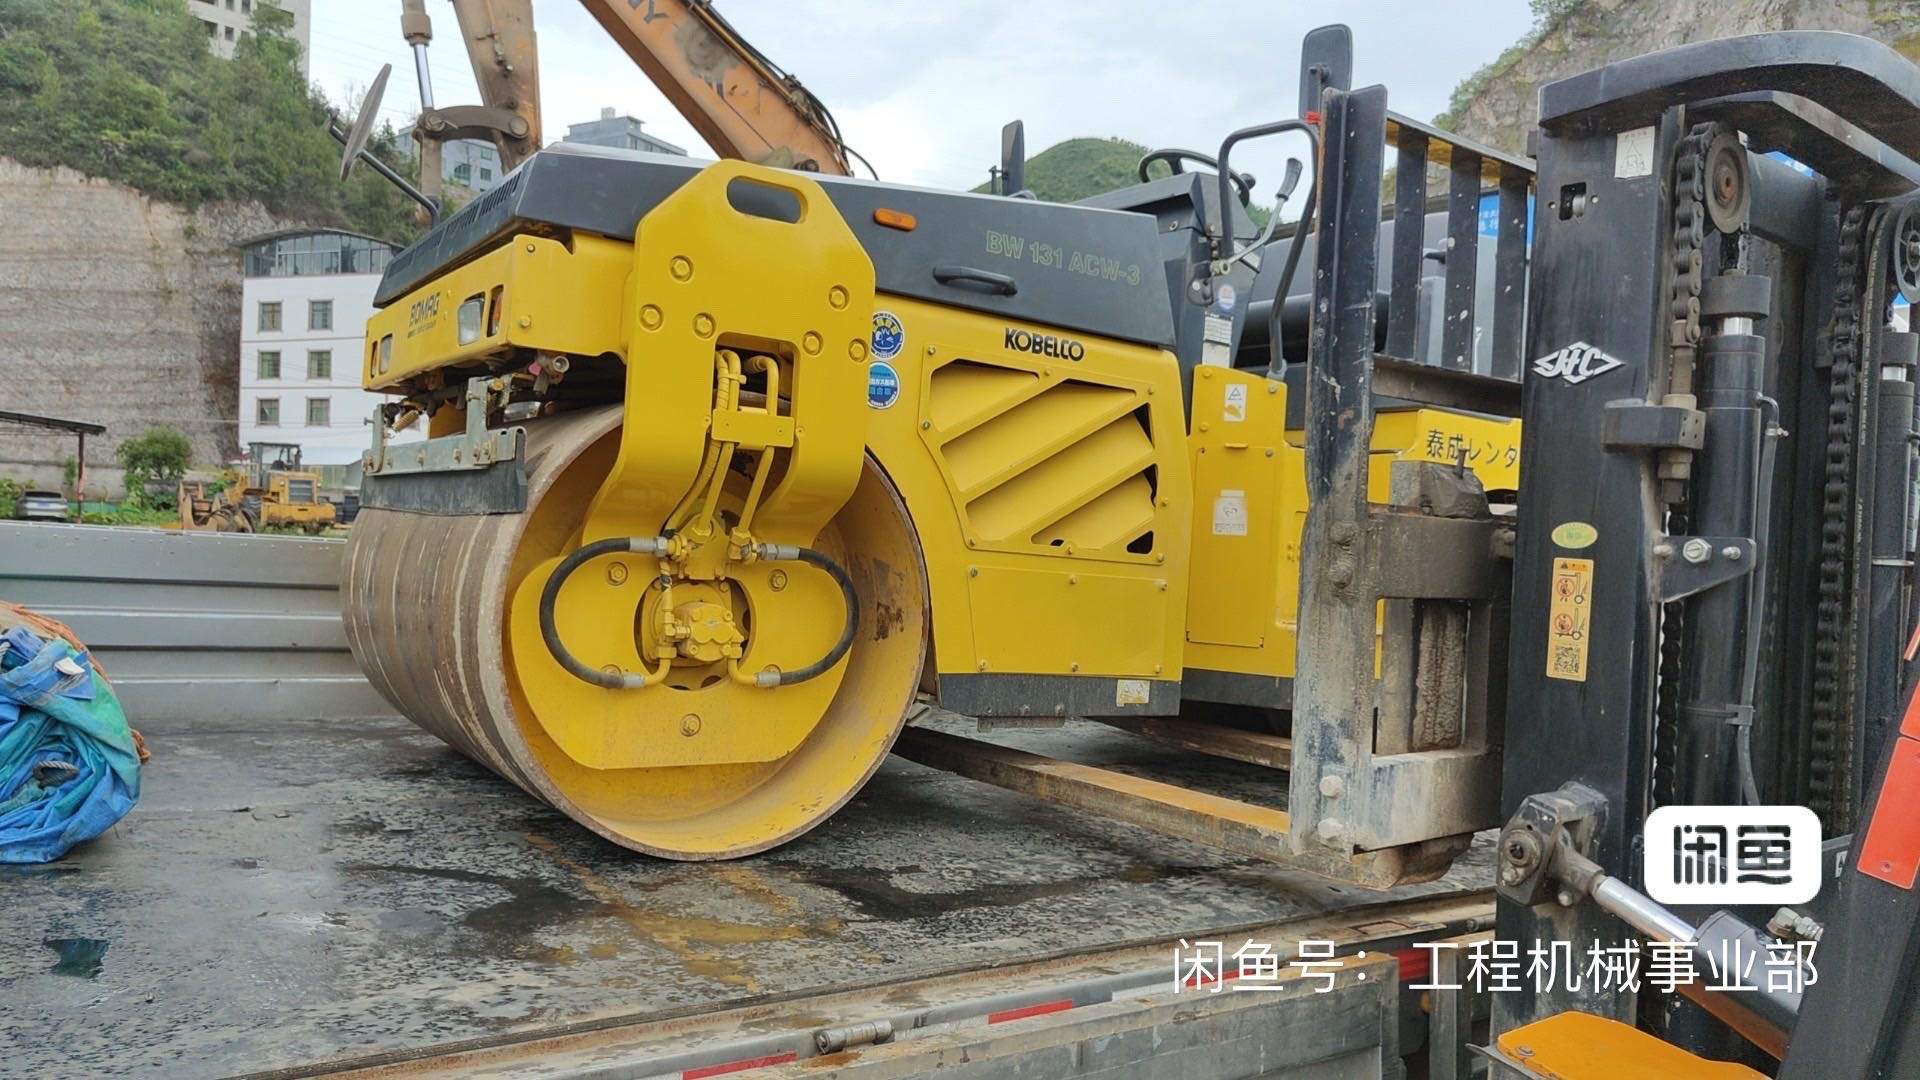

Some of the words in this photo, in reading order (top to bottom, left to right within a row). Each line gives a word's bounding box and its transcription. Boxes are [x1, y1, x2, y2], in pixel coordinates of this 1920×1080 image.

[986, 230, 1025, 260] BW
[1029, 241, 1063, 269] 131
[1068, 252, 1141, 286] ACW-3
[1004, 326, 1085, 362] KOBELCO
